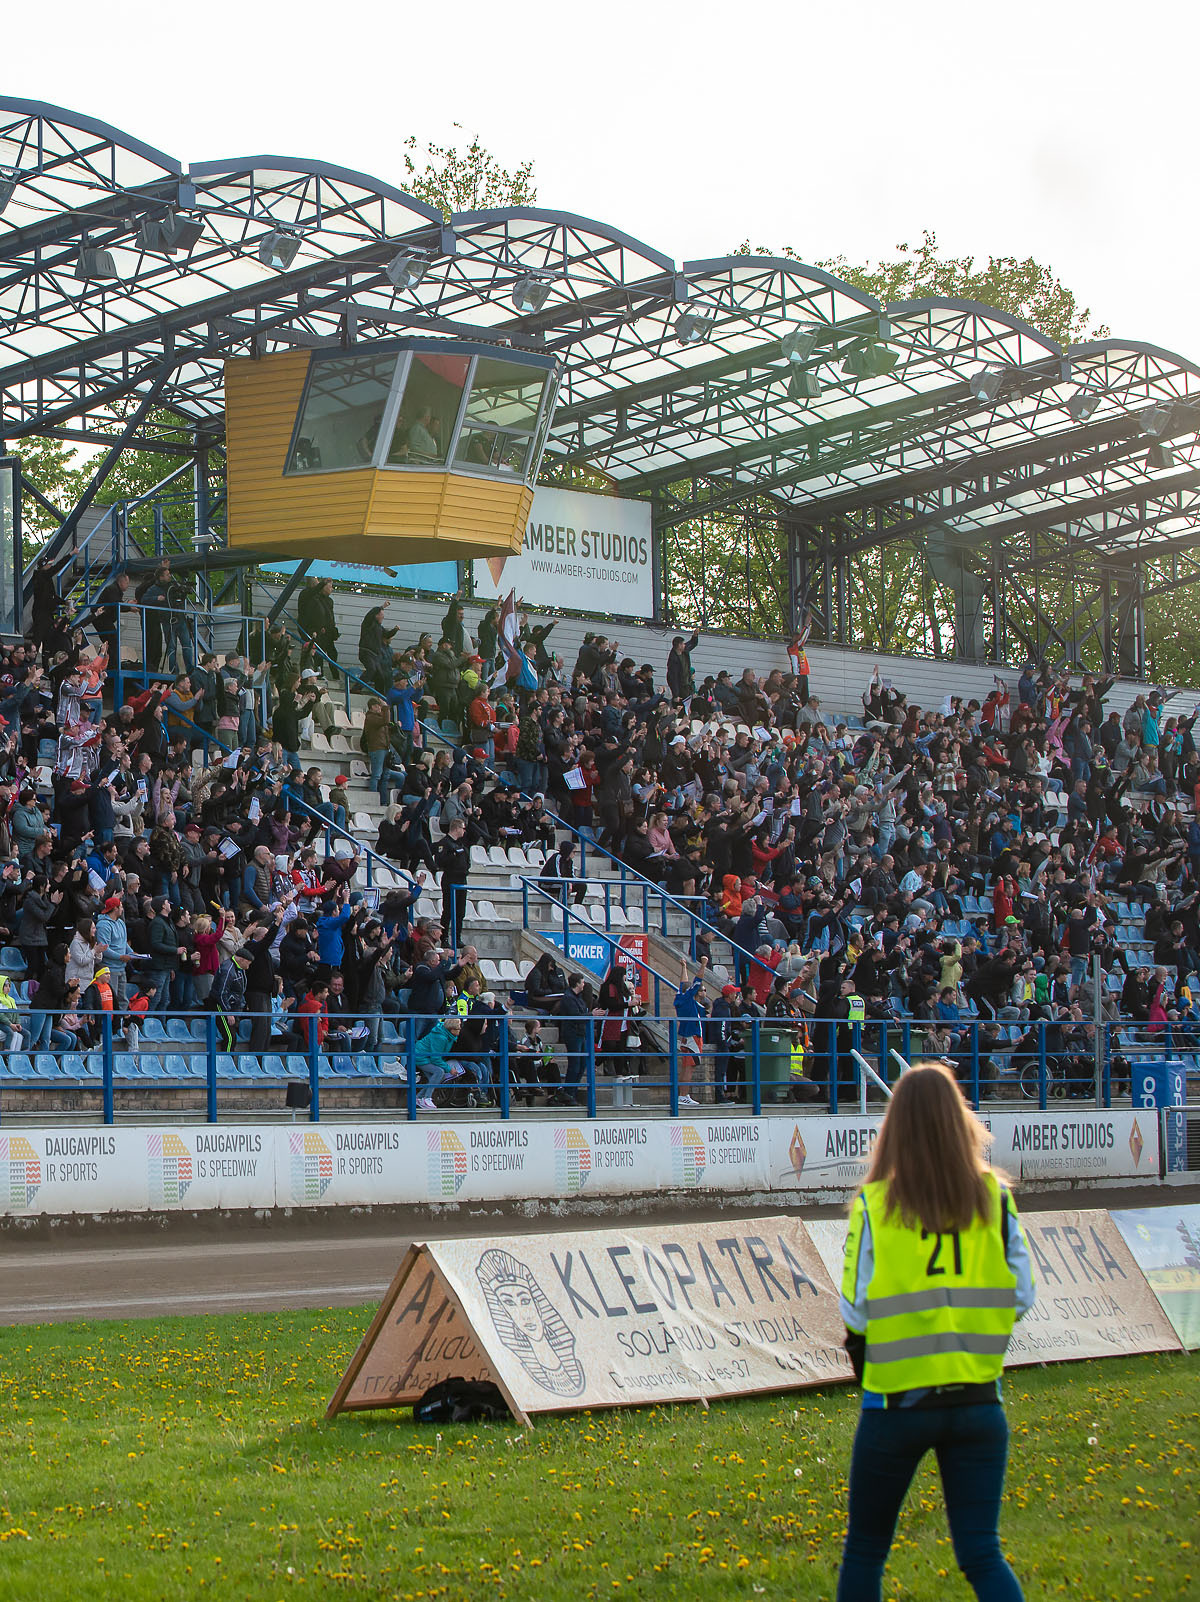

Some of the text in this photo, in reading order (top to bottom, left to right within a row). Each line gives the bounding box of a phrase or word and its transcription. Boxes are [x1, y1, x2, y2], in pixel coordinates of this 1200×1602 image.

[580, 530, 648, 565] STUDIOS
[531, 560, 638, 584] WWW.AMBER-STUDIOS.COM
[196, 1135, 261, 1152] DAUGAVPILS
[336, 1133, 399, 1151] DAUGAVPILS
[470, 1131, 528, 1148] DAUGAVPILS
[594, 1128, 647, 1145] DAUGAVPILS
[708, 1126, 759, 1143] DAUGAVPILS
[1012, 1123, 1114, 1151] AMBER STUDIOS
[45, 1137, 116, 1156] DAUGAVPILS
[471, 1154, 525, 1171] IS SPEEDWAY
[594, 1151, 634, 1167] IR SPORTS
[709, 1148, 756, 1164] IS SPEEDWAY
[46, 1162, 98, 1181] IR SPORTS
[197, 1160, 258, 1178] IS SPEEDWAY
[337, 1157, 383, 1175] IR SPORTS
[921, 1229, 962, 1276] 21
[550, 1236, 818, 1319] KLEOPATRA
[1053, 1295, 1127, 1320] STUDIJA
[617, 1317, 810, 1358] SOLĀRIJU STUDIJA
